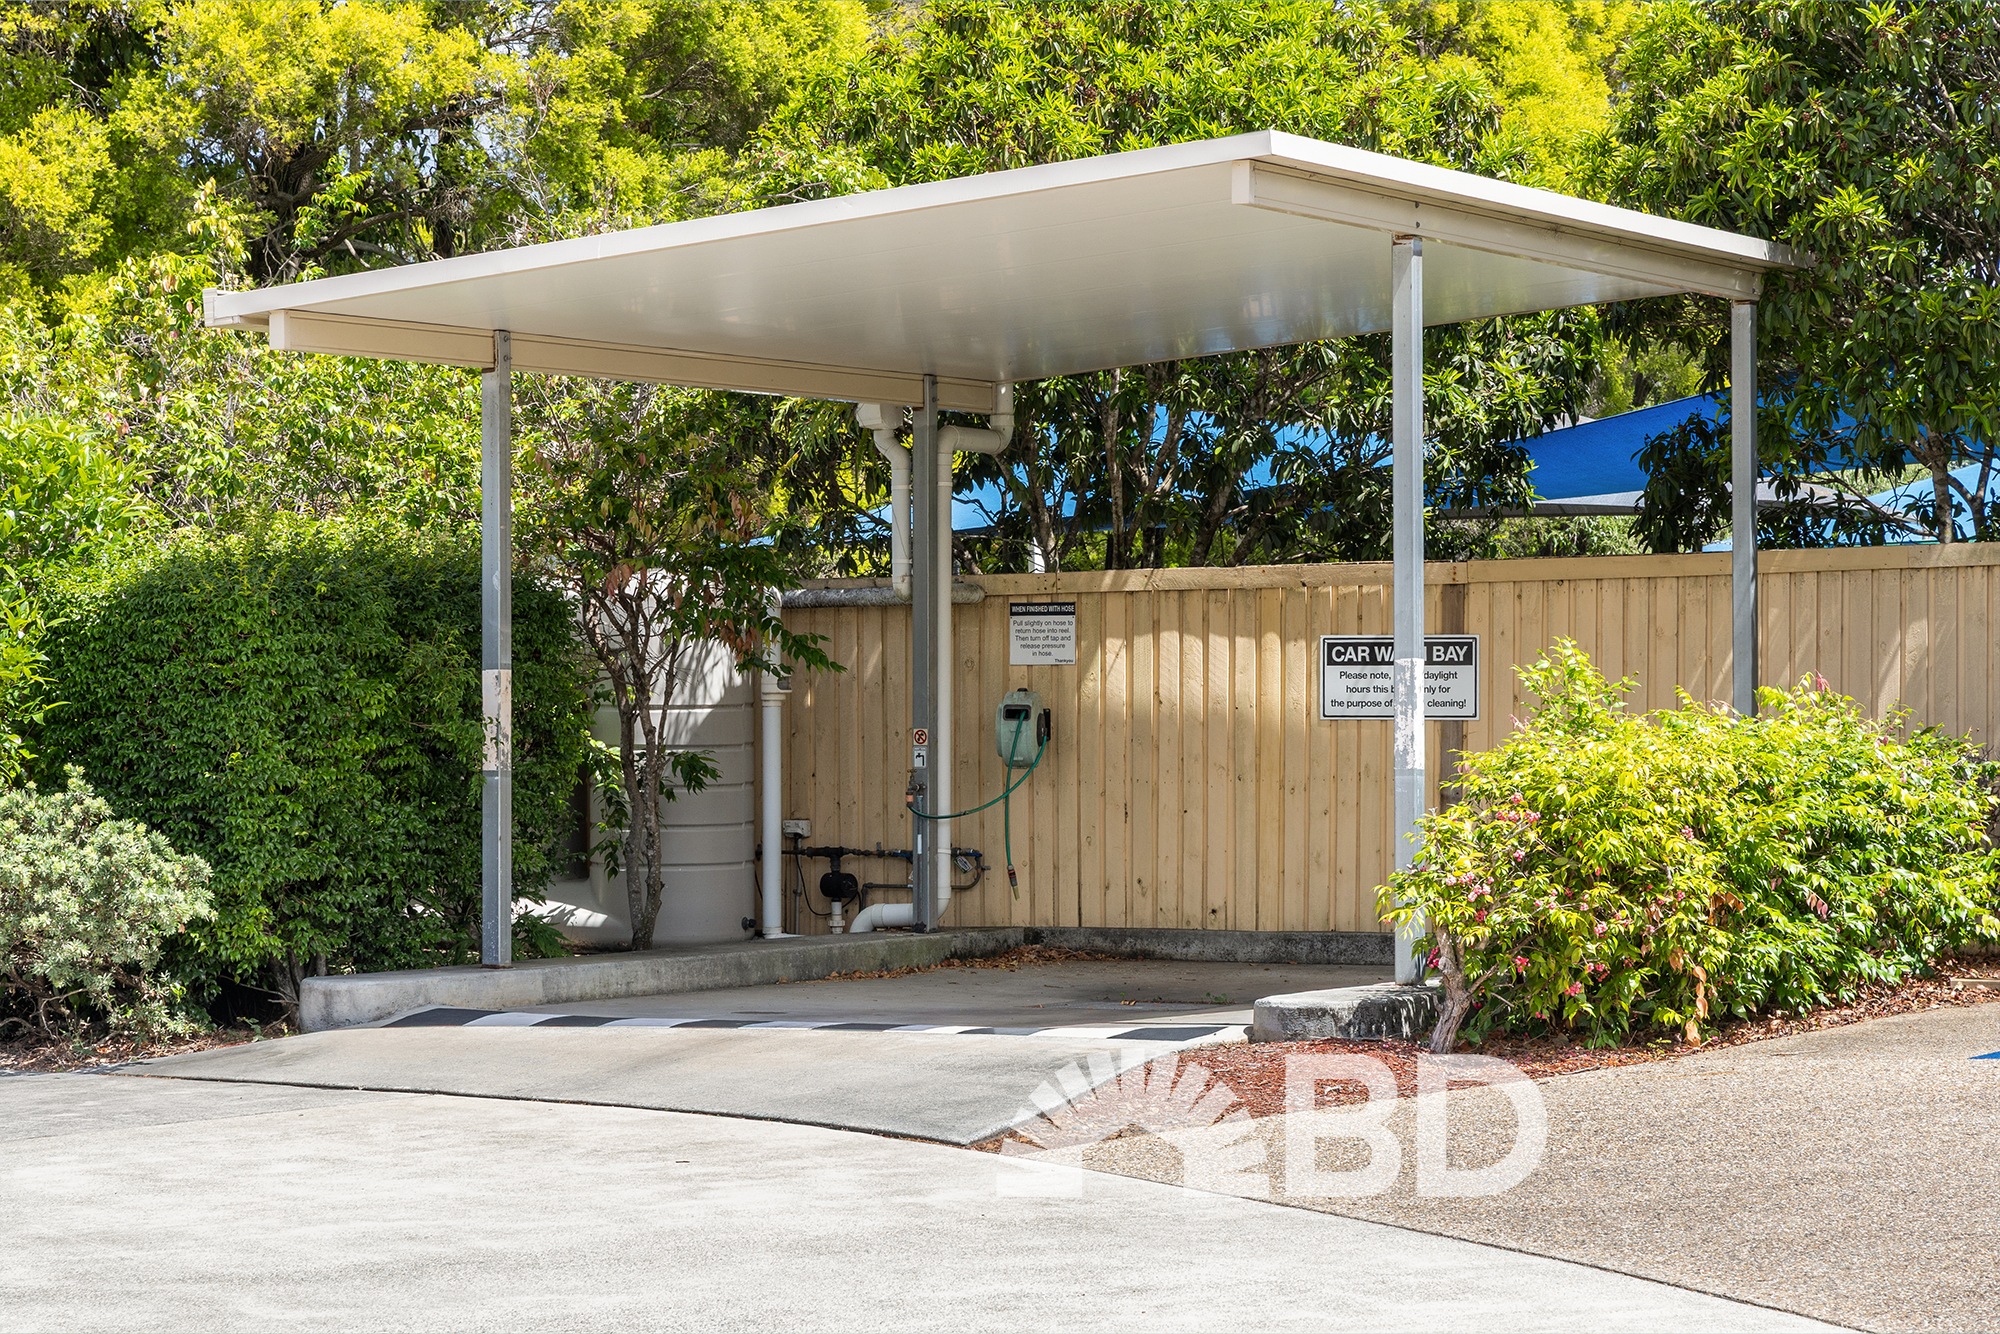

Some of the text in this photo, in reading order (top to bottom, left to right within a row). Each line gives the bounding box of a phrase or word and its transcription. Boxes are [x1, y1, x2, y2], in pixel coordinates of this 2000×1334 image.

[1331, 646, 1370, 662] CAR
[1433, 646, 1468, 662] BAY
[1340, 671, 1457, 682] Please note, daylight
[1346, 685, 1370, 693] hours
[1373, 685, 1389, 693] this
[1424, 685, 1434, 695] nly
[1438, 685, 1450, 693] for
[1331, 699, 1466, 709] the purpose of cleaning!
